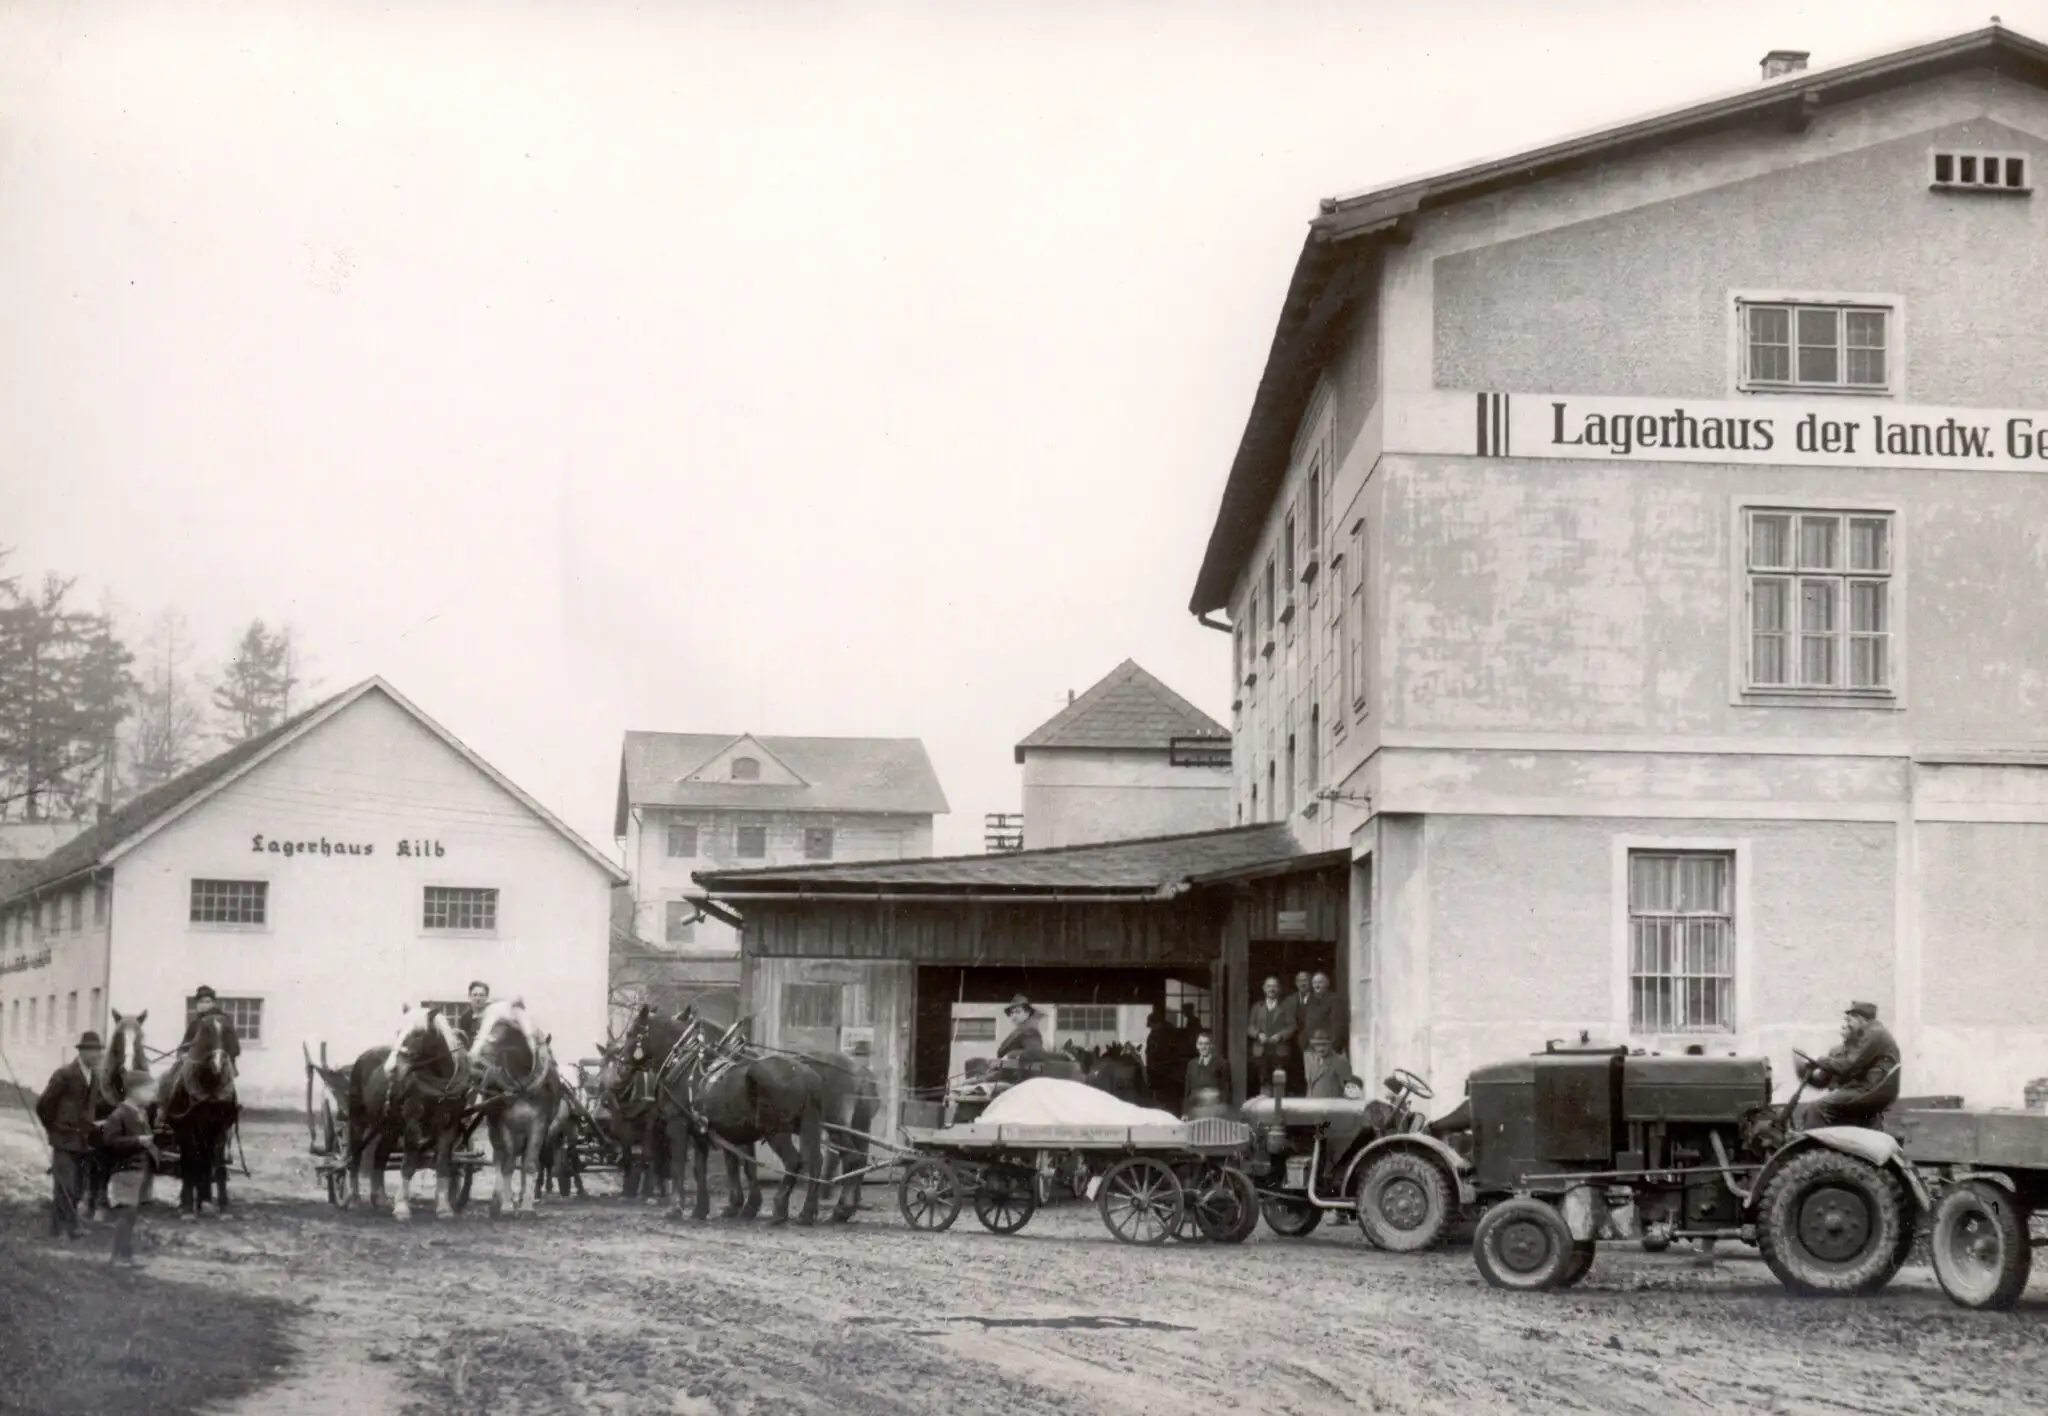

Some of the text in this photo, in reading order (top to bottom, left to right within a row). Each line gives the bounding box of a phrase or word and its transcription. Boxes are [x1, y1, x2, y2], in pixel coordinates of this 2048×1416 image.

[1550, 403, 1774, 455] Lagerhaus
[1796, 413, 1860, 453] der
[1873, 415, 1994, 458] landw.
[251, 833, 445, 858] Lagerhaus Kilb
